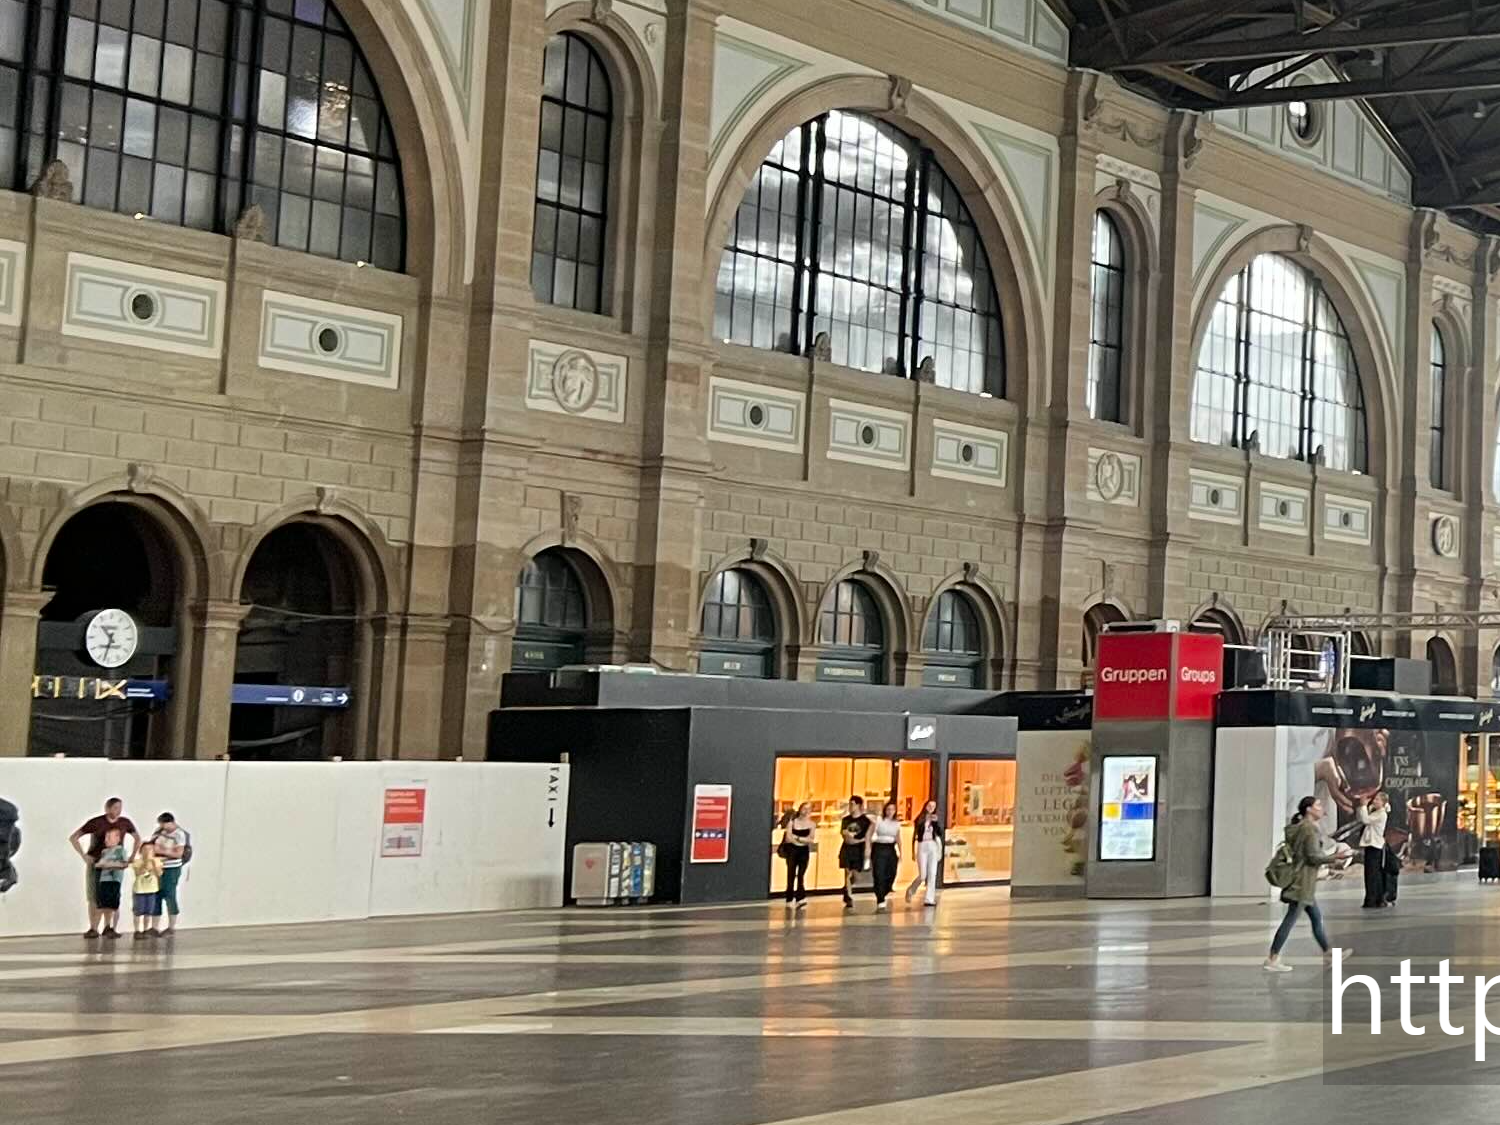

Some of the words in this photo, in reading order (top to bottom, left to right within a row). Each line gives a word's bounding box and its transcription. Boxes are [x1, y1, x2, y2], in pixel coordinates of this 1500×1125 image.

[1101, 667, 1167, 683] Gruppen
[1181, 666, 1216, 684] Groups
[548, 766, 560, 801] TAXI
